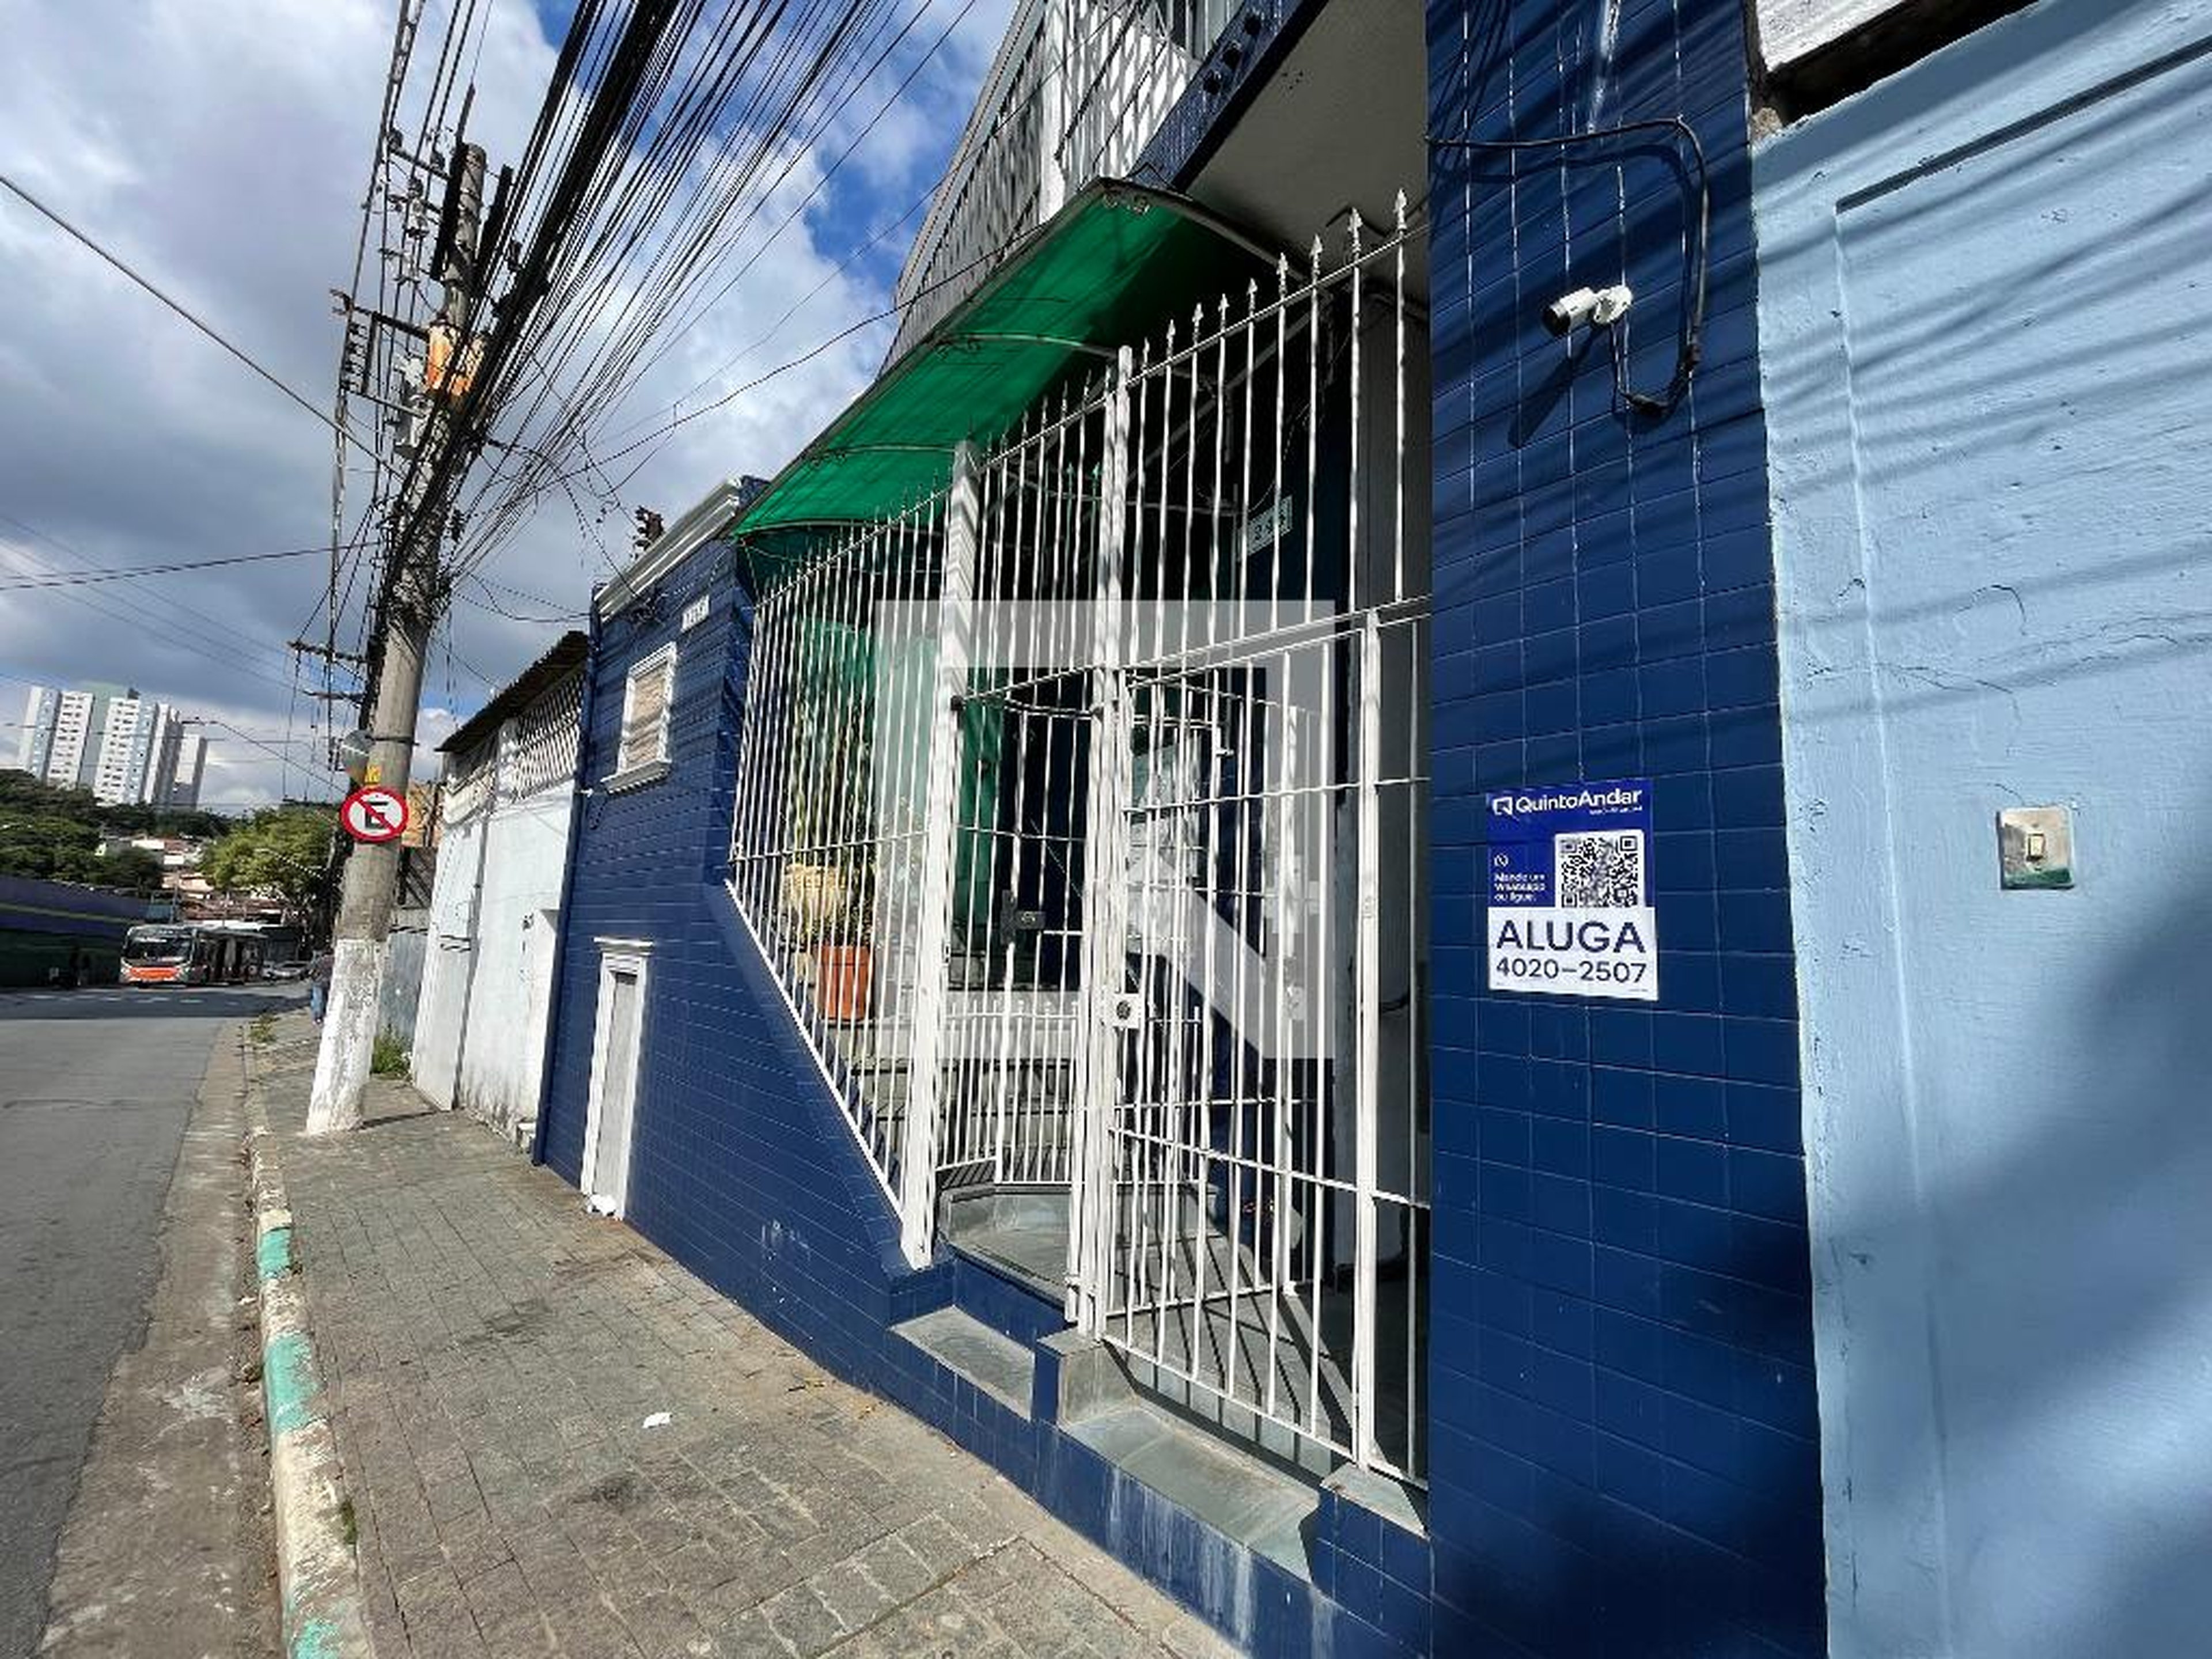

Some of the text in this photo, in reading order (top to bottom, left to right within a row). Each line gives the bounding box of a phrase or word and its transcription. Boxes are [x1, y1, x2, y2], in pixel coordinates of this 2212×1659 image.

[1516, 787, 1642, 813] QuintoAndar
[1497, 920, 1646, 953] ALUGA
[1497, 957, 1647, 983] 4020-2507
